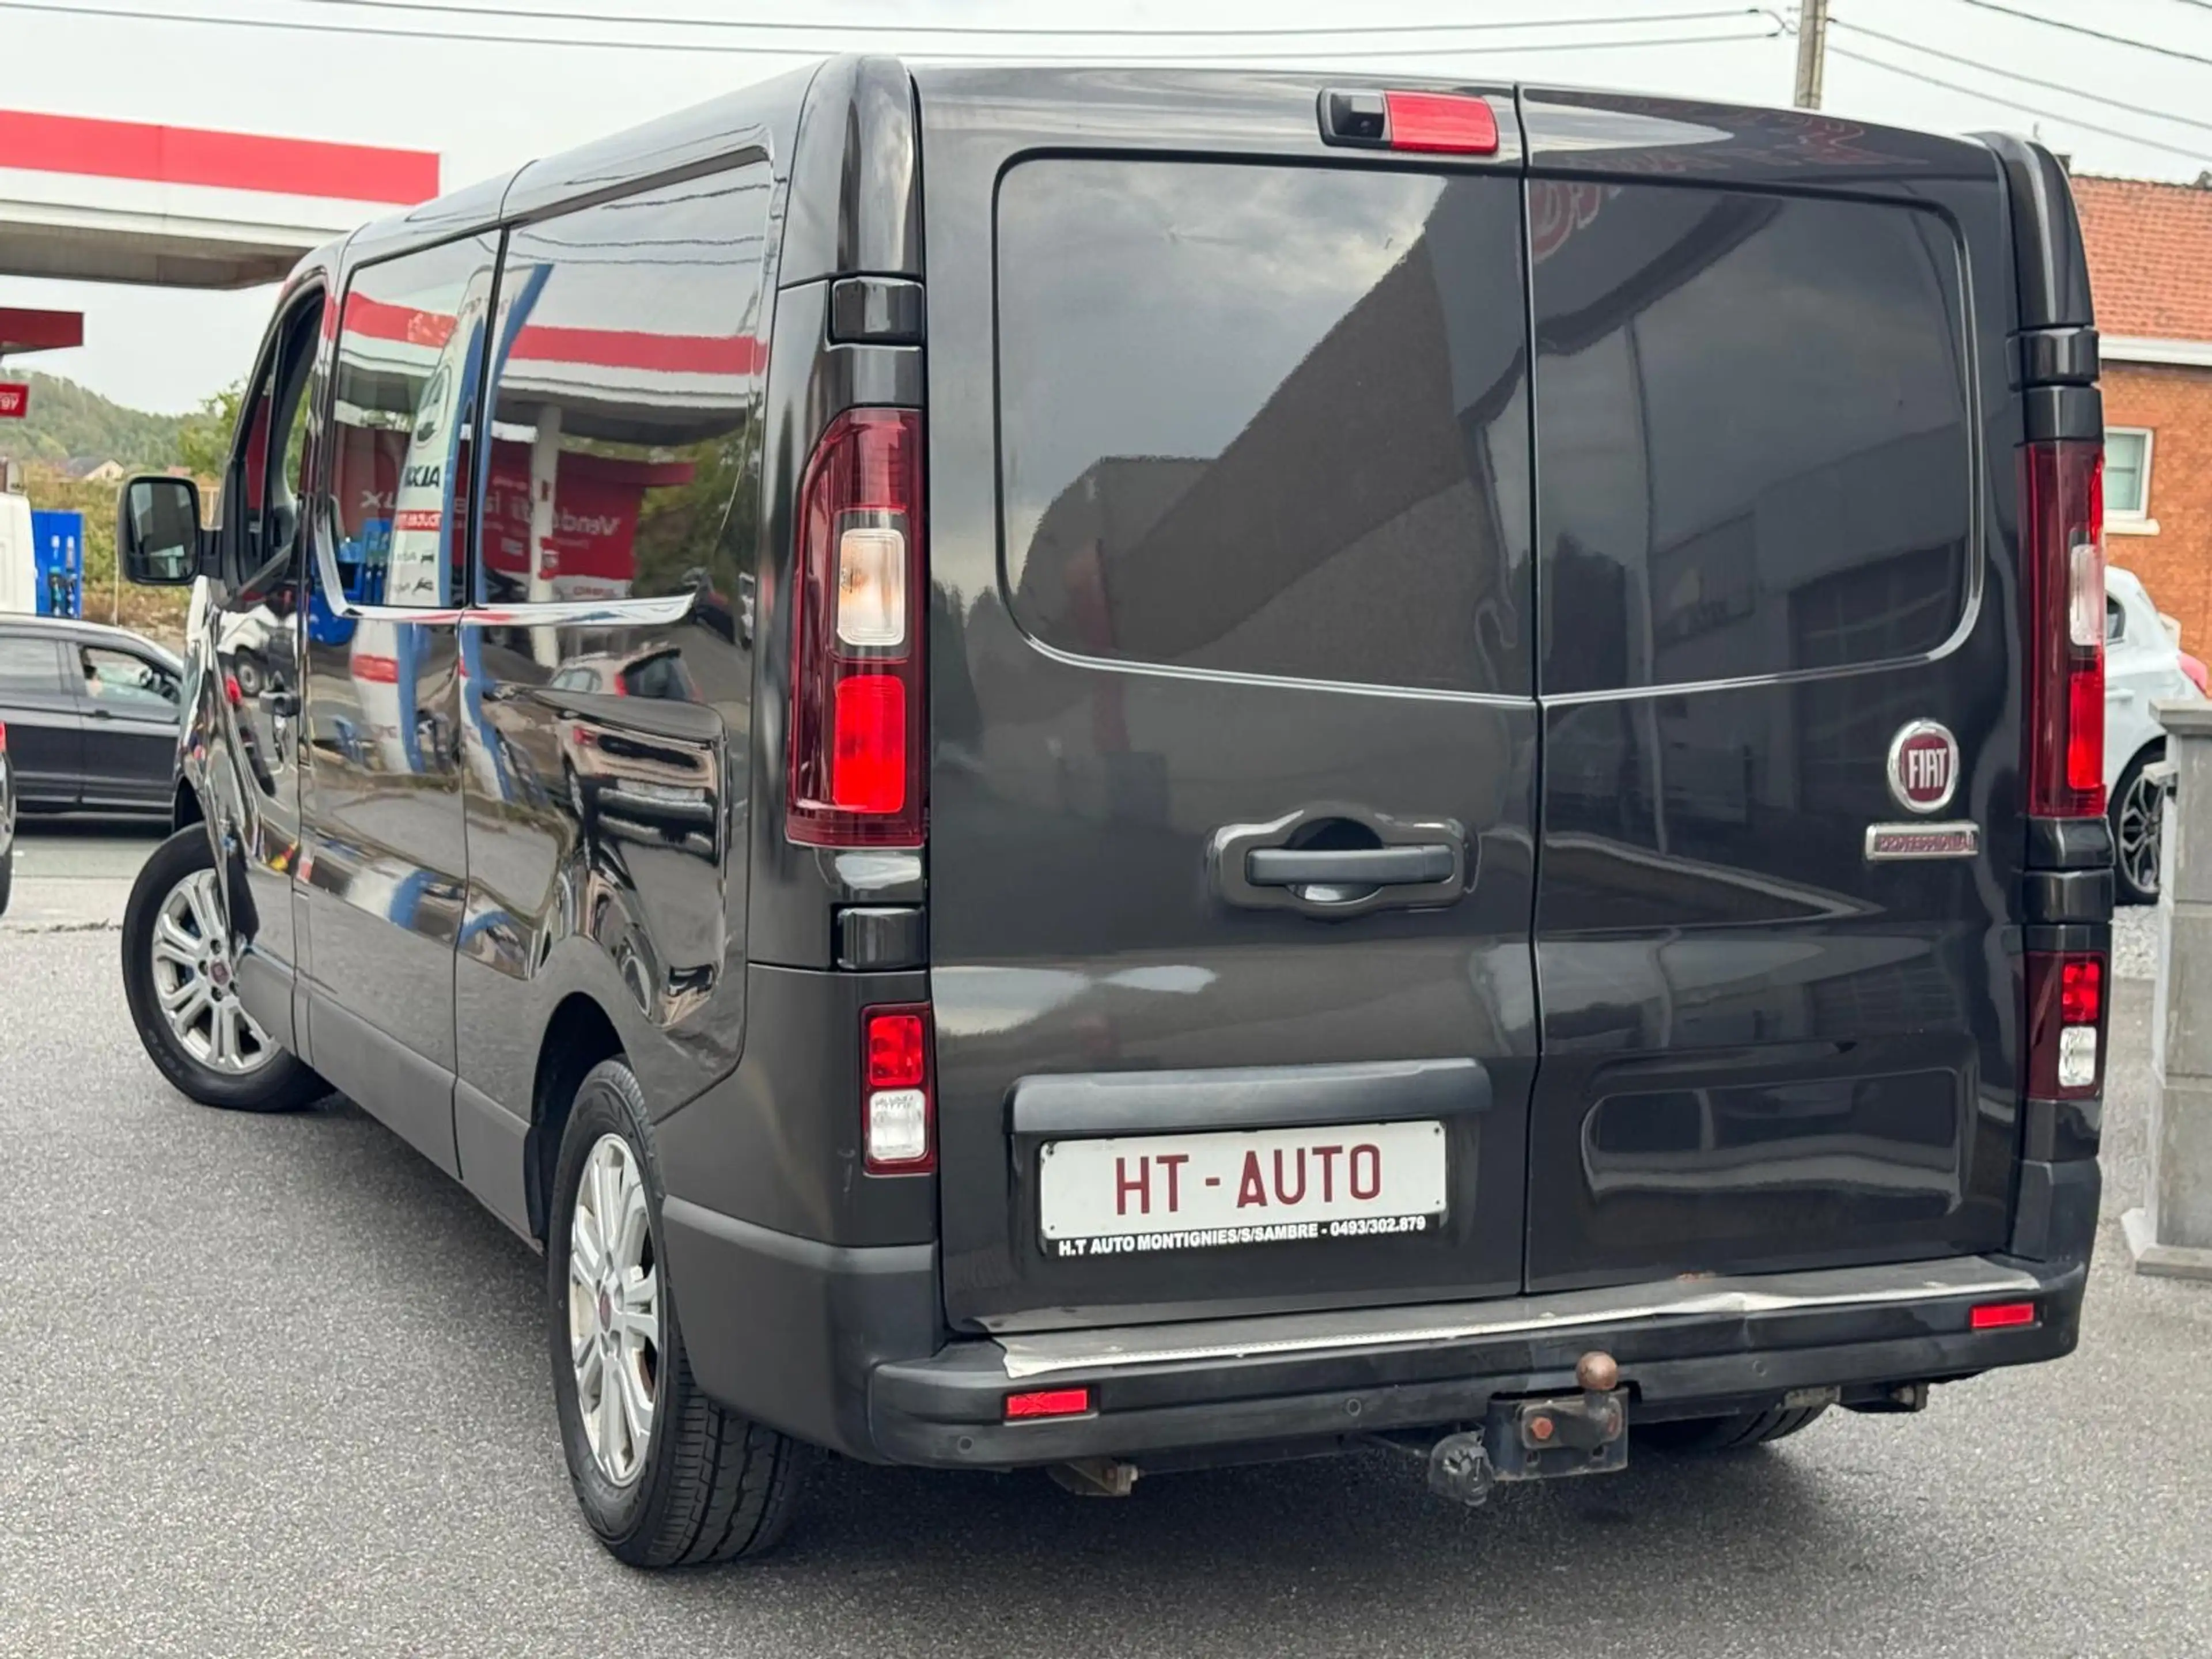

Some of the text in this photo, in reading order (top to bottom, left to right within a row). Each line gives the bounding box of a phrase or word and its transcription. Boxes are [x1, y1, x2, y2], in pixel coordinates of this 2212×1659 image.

[1908, 747, 1948, 789] FIAT
[1115, 1154, 1189, 1215] HT
[1236, 1144, 1381, 1209] AUTO
[1058, 1238, 1087, 1256] H.T
[1090, 1234, 1135, 1255] AUTO
[1138, 1224, 1318, 1249] MONTIGNIES/S/SAMBRE
[1330, 1215, 1426, 1237] 0493/302.879
